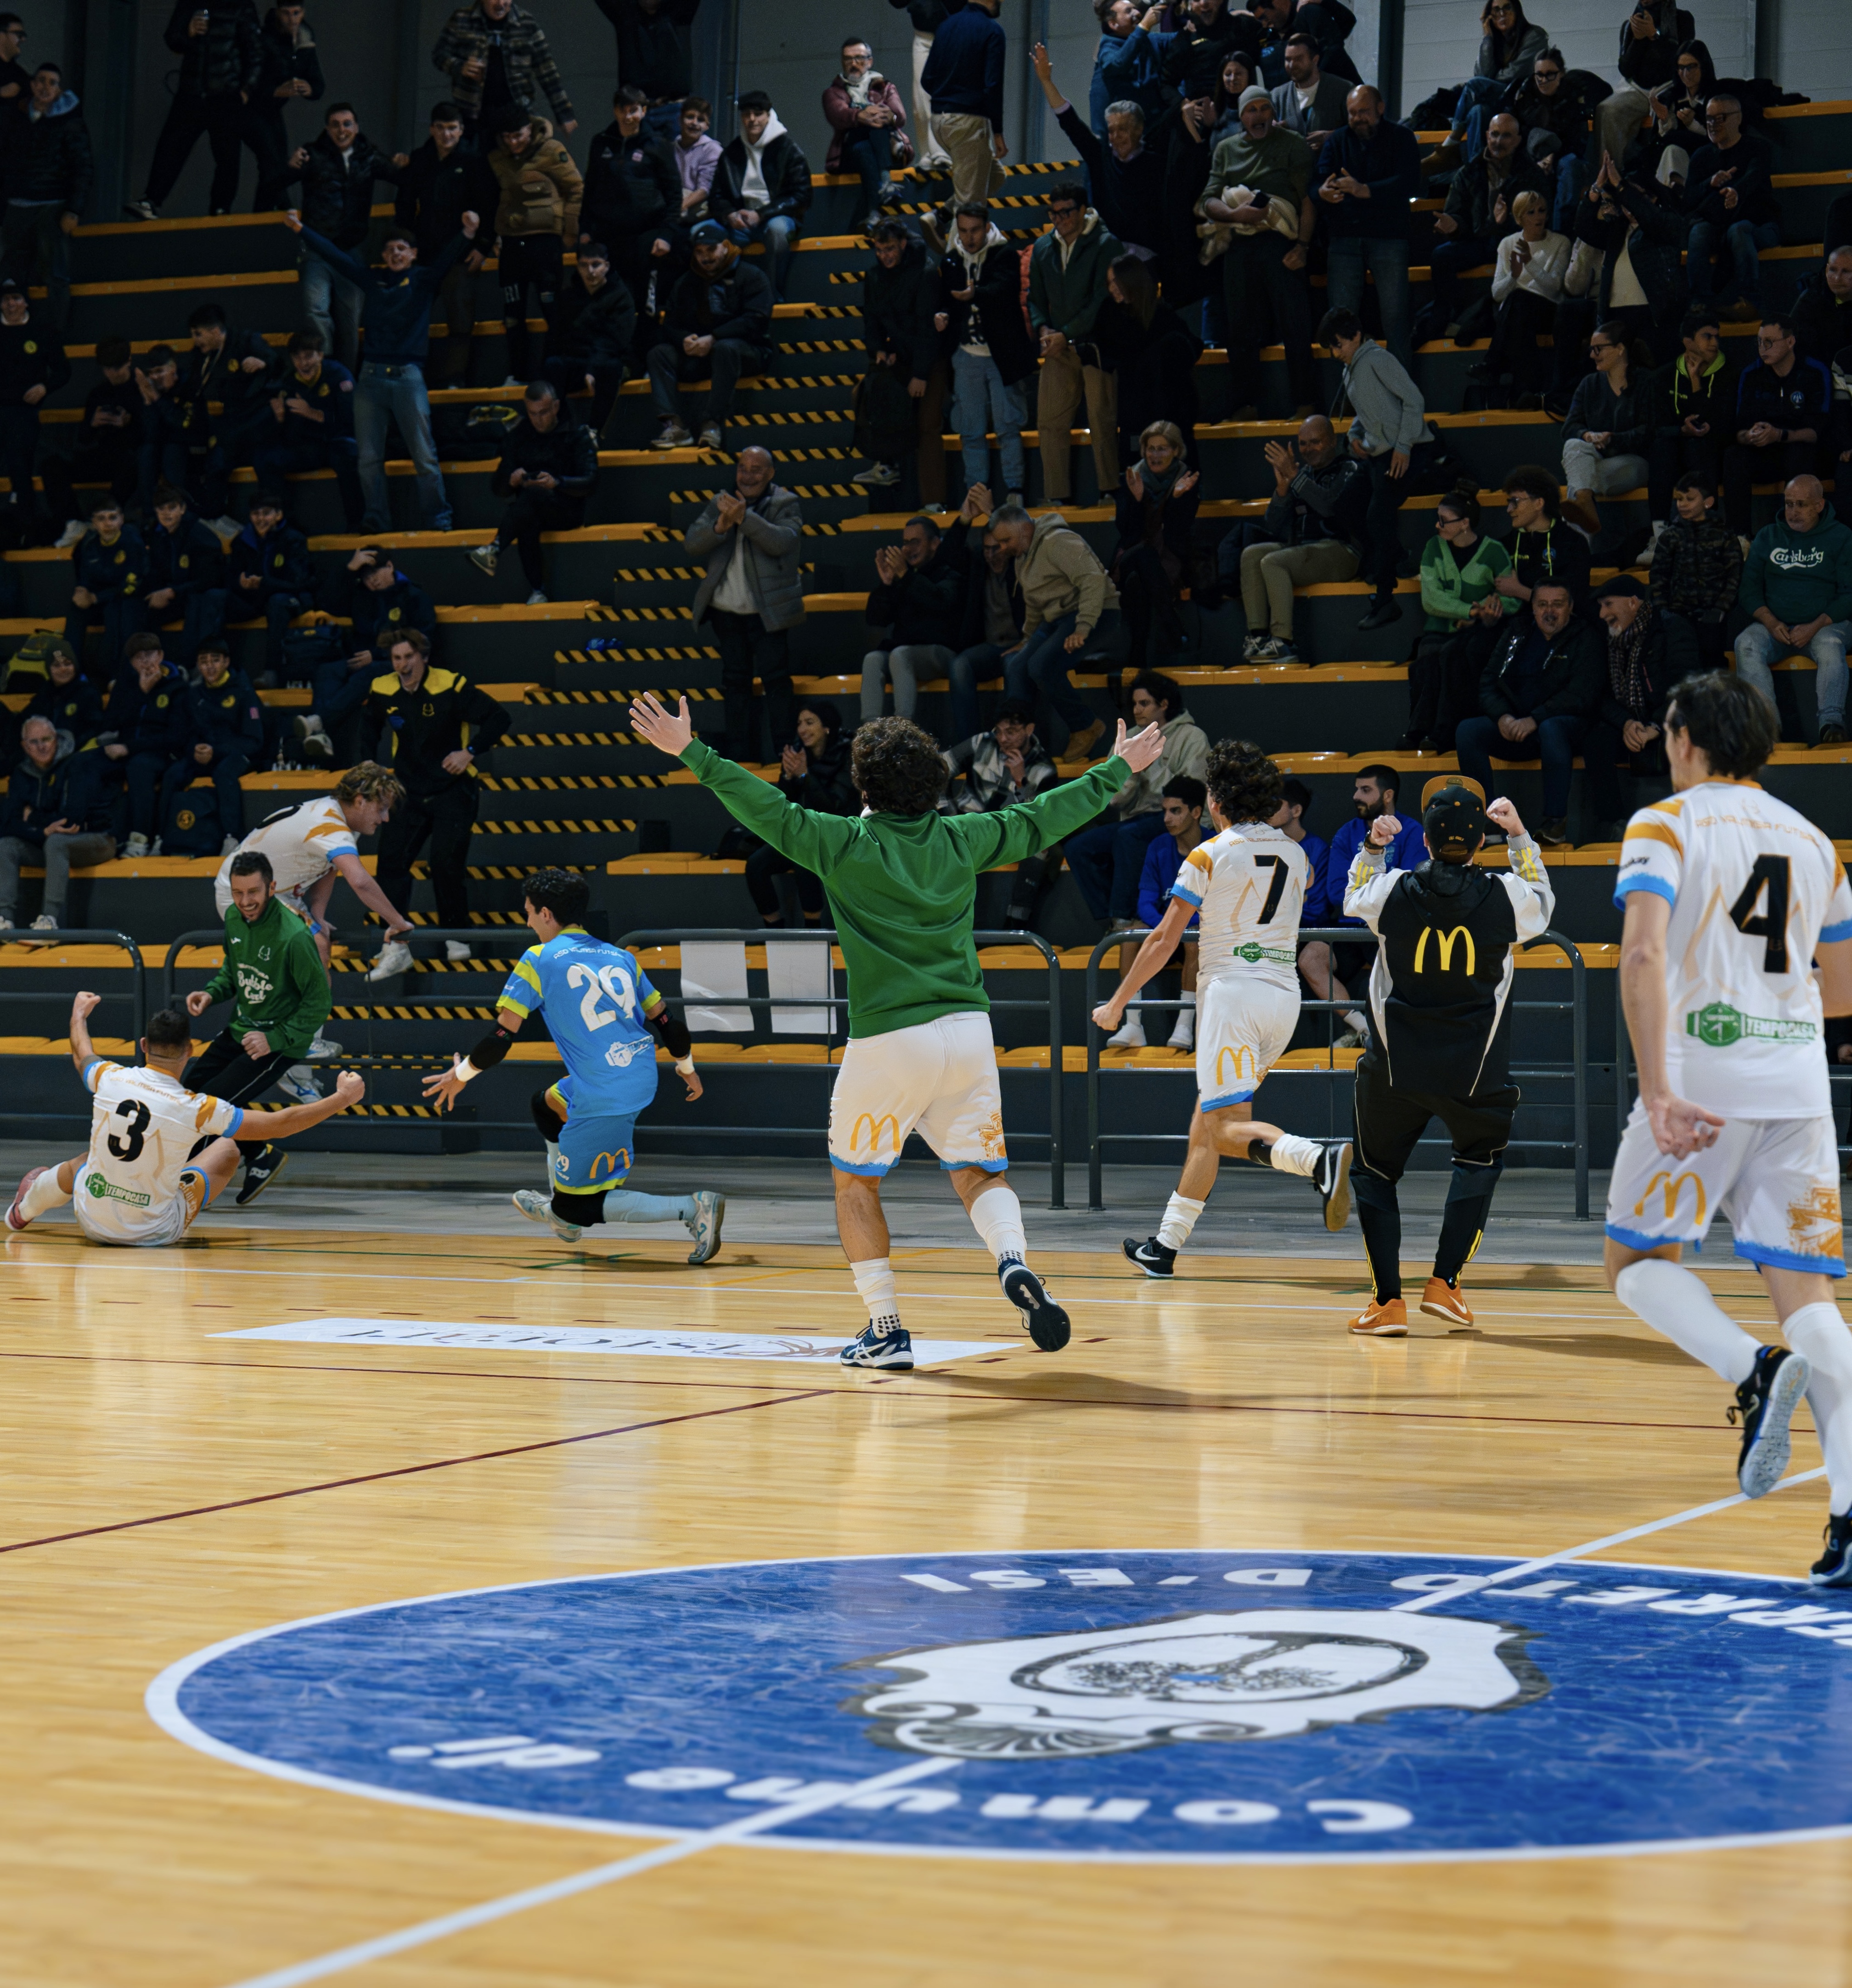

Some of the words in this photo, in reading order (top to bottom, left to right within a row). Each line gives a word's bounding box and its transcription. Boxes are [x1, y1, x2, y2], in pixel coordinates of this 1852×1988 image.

[1770, 546, 1824, 570] Carlsberg
[1253, 855, 1289, 925] 7
[1728, 853, 1792, 974] 4
[567, 963, 636, 1032] 29
[108, 1099, 151, 1162] 3
[108, 1185, 150, 1205] TEMPOCASA
[899, 1568, 1312, 1592] D'ESI
[1390, 1565, 1852, 1647] ERRETO
[388, 1735, 602, 1768] di
[625, 1767, 1413, 1832] Comune
